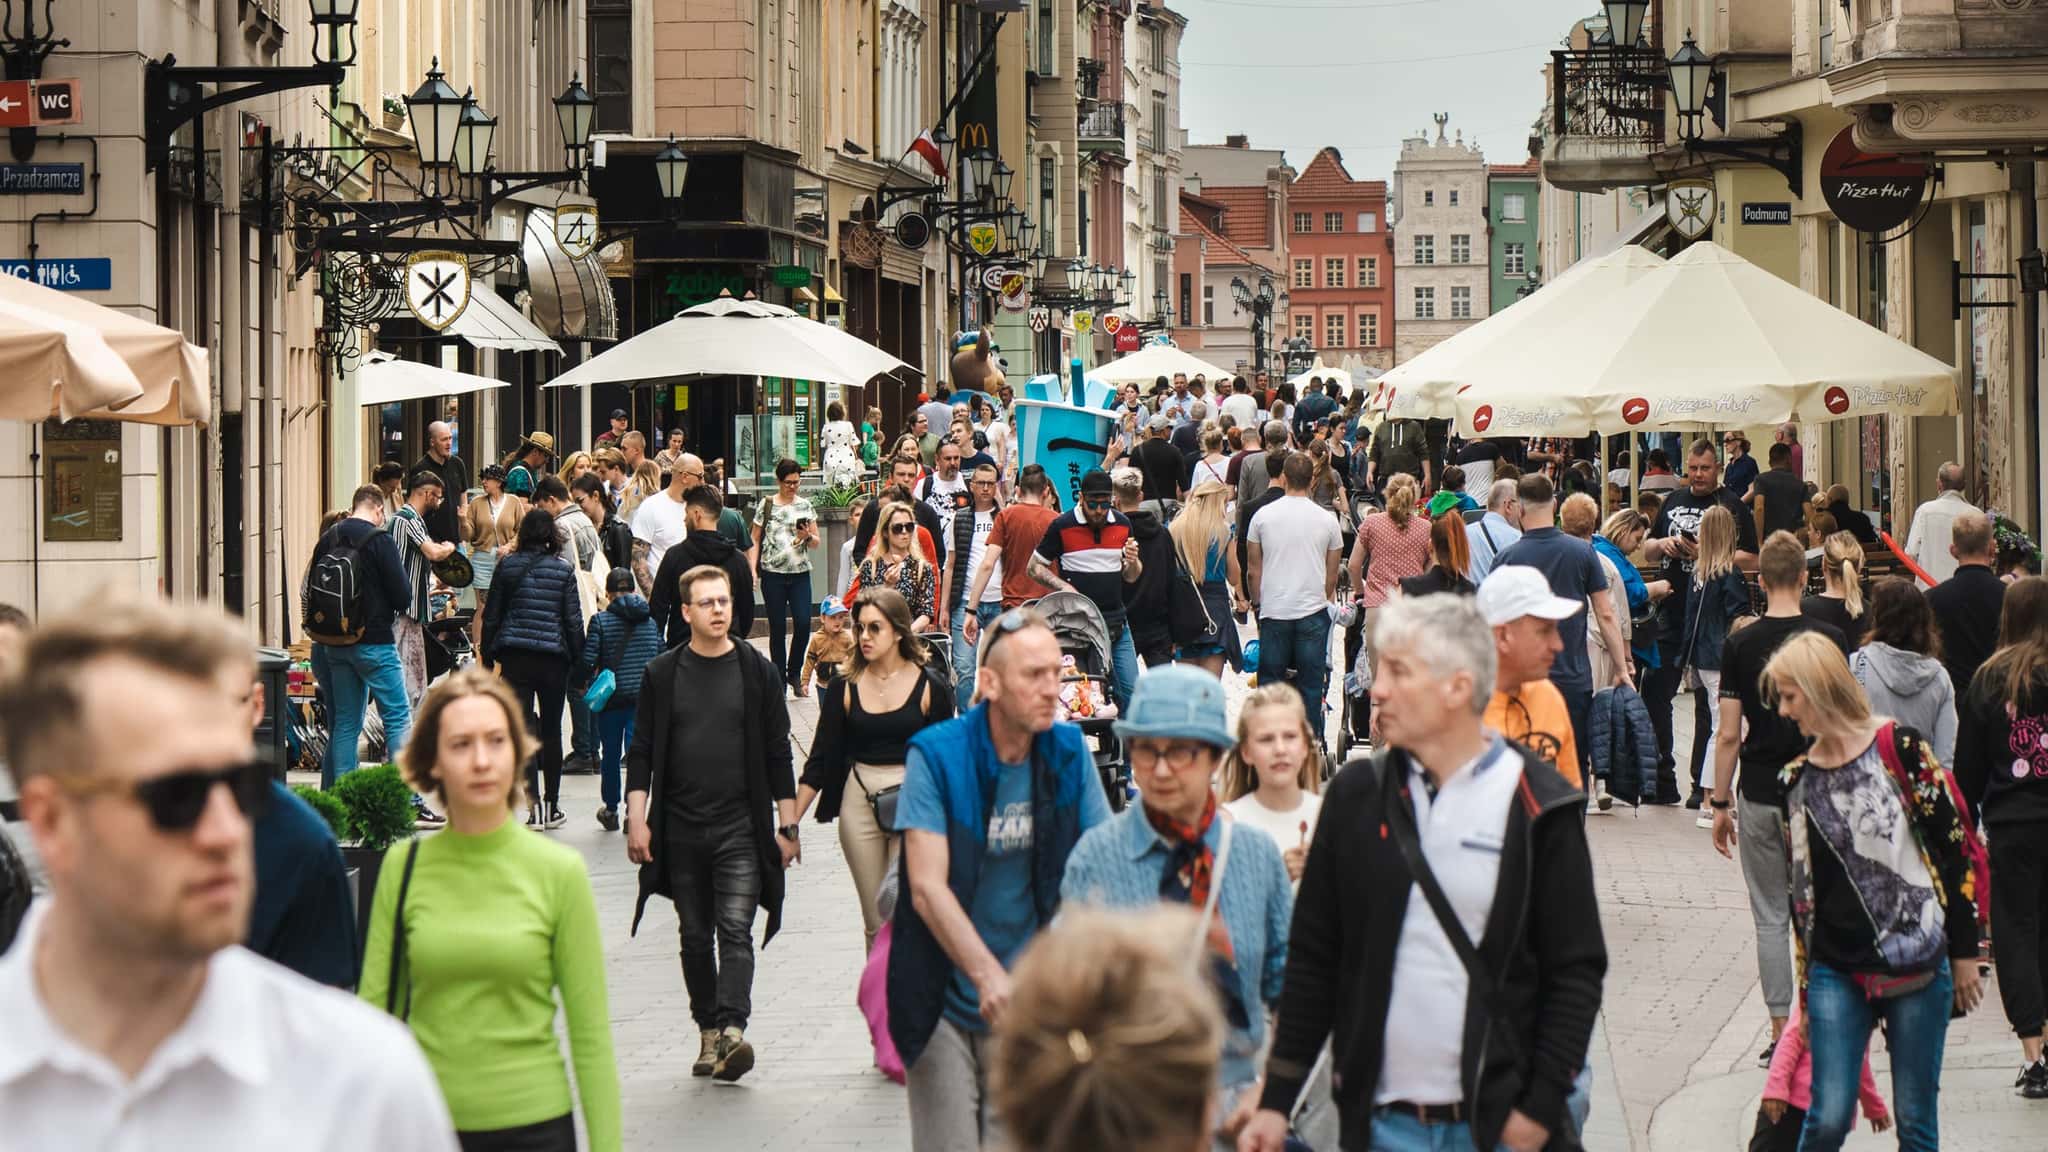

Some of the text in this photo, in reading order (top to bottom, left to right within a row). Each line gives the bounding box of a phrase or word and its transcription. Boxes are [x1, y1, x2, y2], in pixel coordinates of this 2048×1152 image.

[41, 94, 70, 110] WC
[3, 167, 80, 189] Przedzamcze
[1837, 182, 1912, 199] Pizza Hut
[1744, 207, 1789, 220] Podmurna
[1120, 334, 1137, 342] hebe
[1852, 384, 1928, 407] Pizza Hut
[1653, 393, 1760, 418] Pizza Hut
[974, 522, 993, 533] FIG
